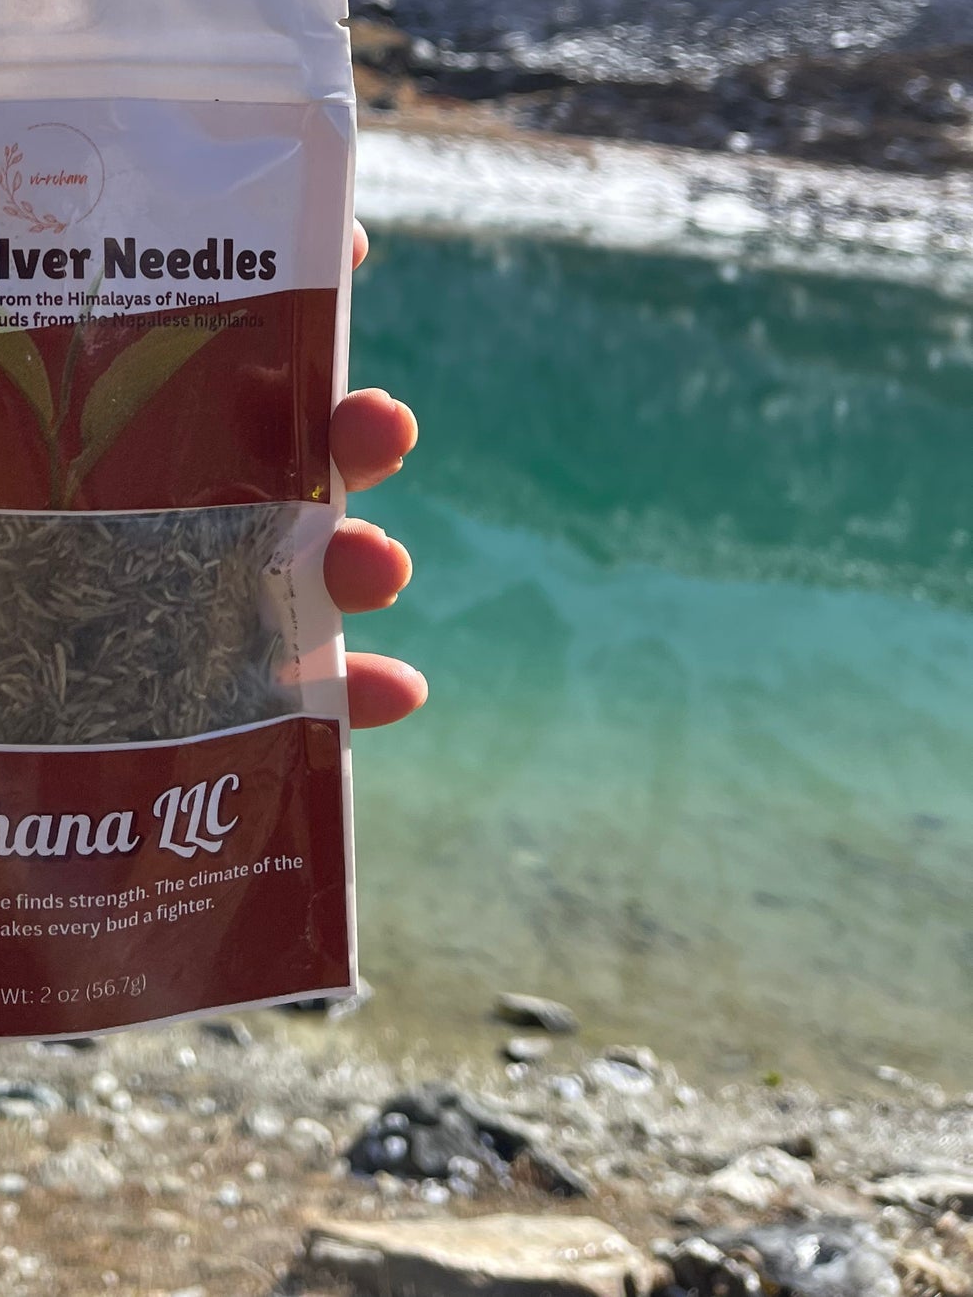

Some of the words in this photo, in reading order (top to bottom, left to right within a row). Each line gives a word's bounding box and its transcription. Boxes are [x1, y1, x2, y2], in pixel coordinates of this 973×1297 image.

[104, 237, 277, 281] Needles
[33, 311, 74, 327] from
[78, 312, 107, 327] the
[113, 312, 190, 330] Nepalese
[194, 312, 264, 331] highlands
[35, 291, 63, 306] the
[68, 291, 151, 309] Himalayas
[155, 291, 172, 306] of
[176, 292, 219, 309] Nepal
[153, 773, 239, 858] LLC
[16, 893, 63, 910] finds
[69, 886, 150, 909] strength.
[155, 879, 184, 895] The
[189, 864, 248, 889] climate
[253, 858, 270, 874] of
[275, 855, 303, 871] the
[48, 921, 101, 939] every
[106, 911, 138, 932] bud
[143, 910, 152, 923] a
[157, 897, 215, 921] fighter.
[1, 988, 34, 1005] Wt:
[40, 986, 52, 1003] 2
[57, 988, 79, 1003] oz
[86, 974, 147, 1001] (56.7g)
